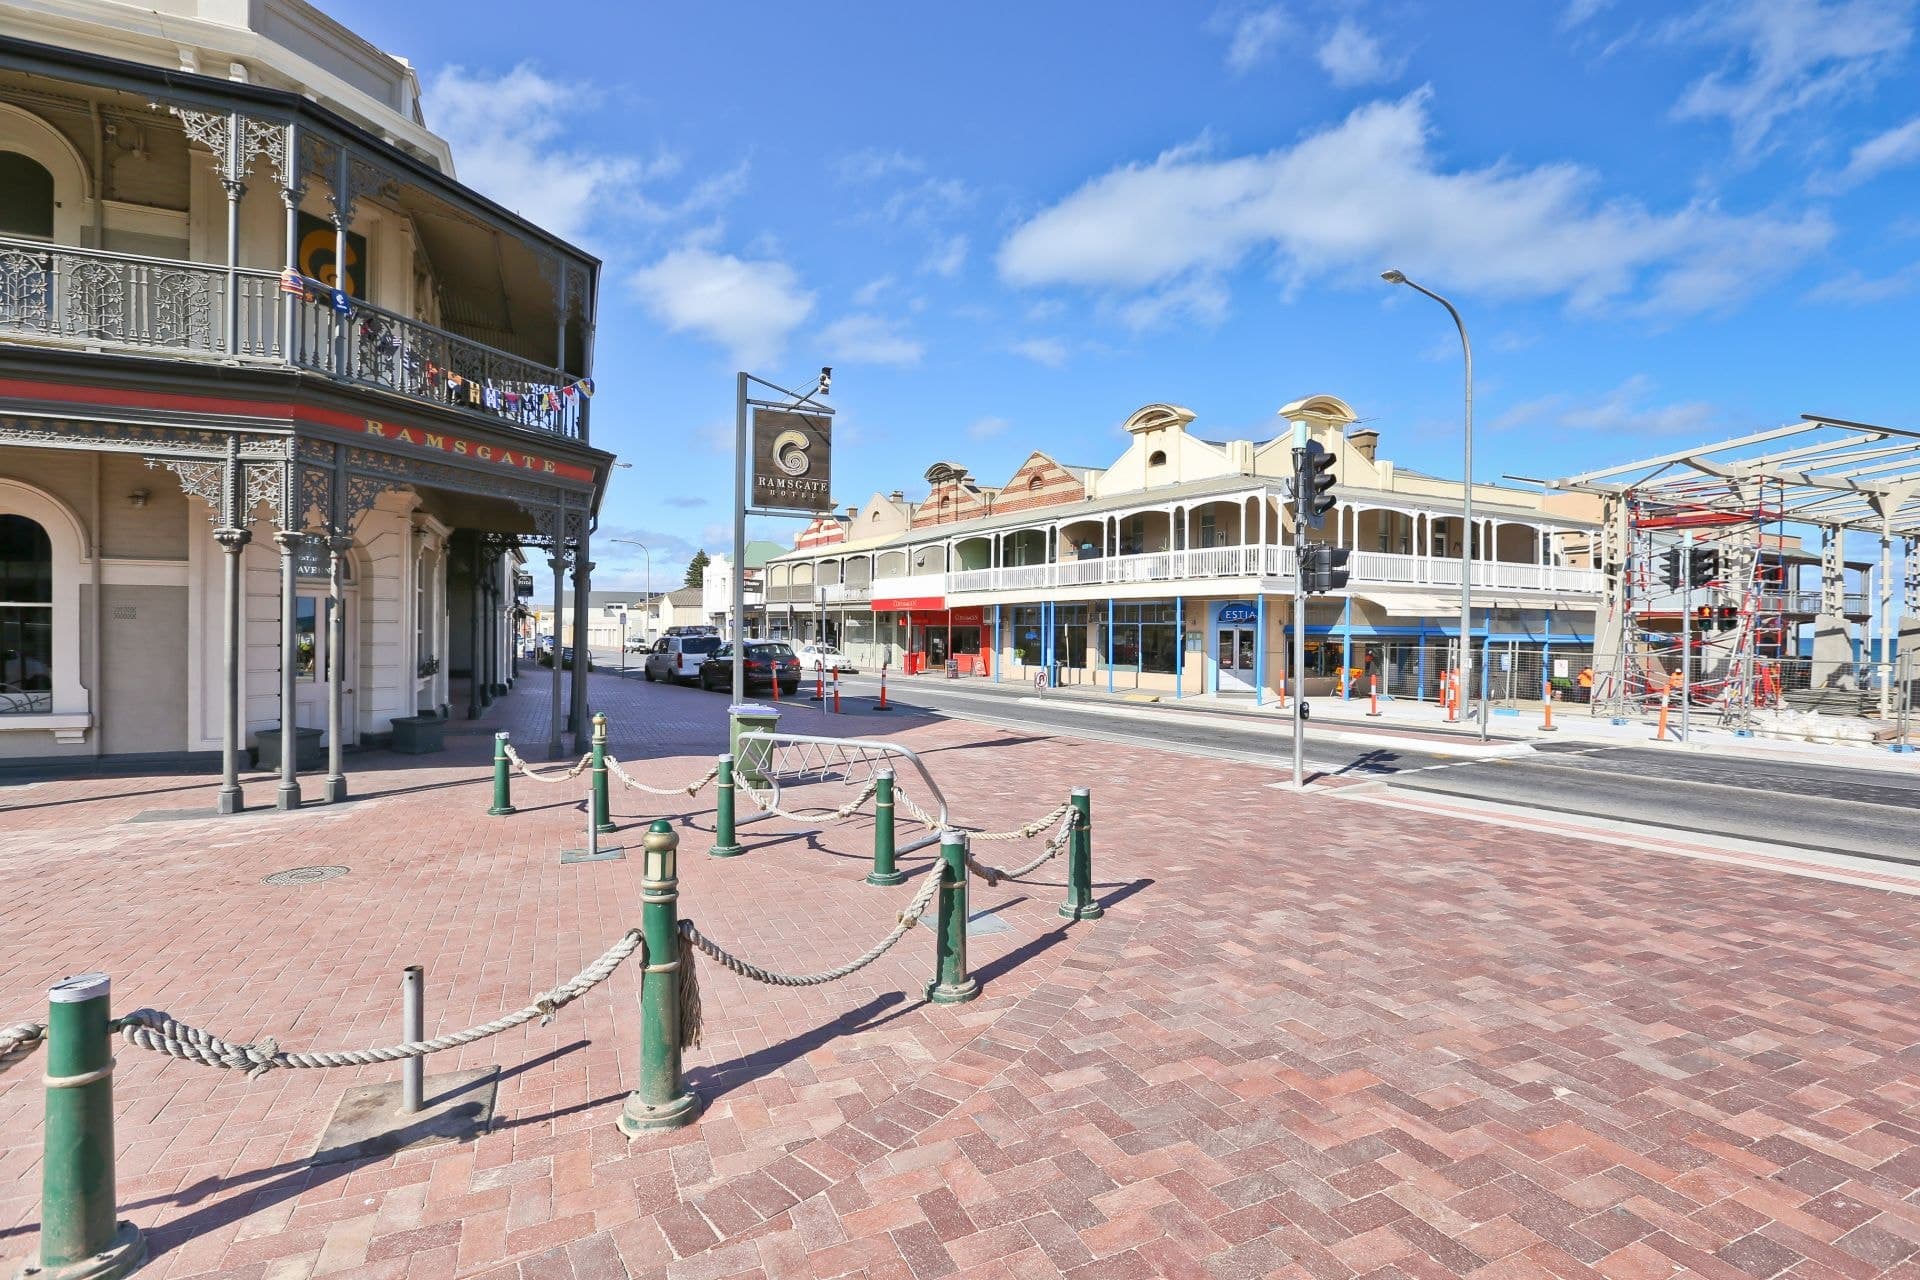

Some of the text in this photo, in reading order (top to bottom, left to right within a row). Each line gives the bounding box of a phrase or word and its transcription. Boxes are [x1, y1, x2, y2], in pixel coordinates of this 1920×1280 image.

[365, 419, 556, 474] RAMSGATE
[758, 476, 828, 492] RAMSGATE
[770, 489, 817, 499] HOTEL
[1225, 610, 1256, 619] ESTIA
